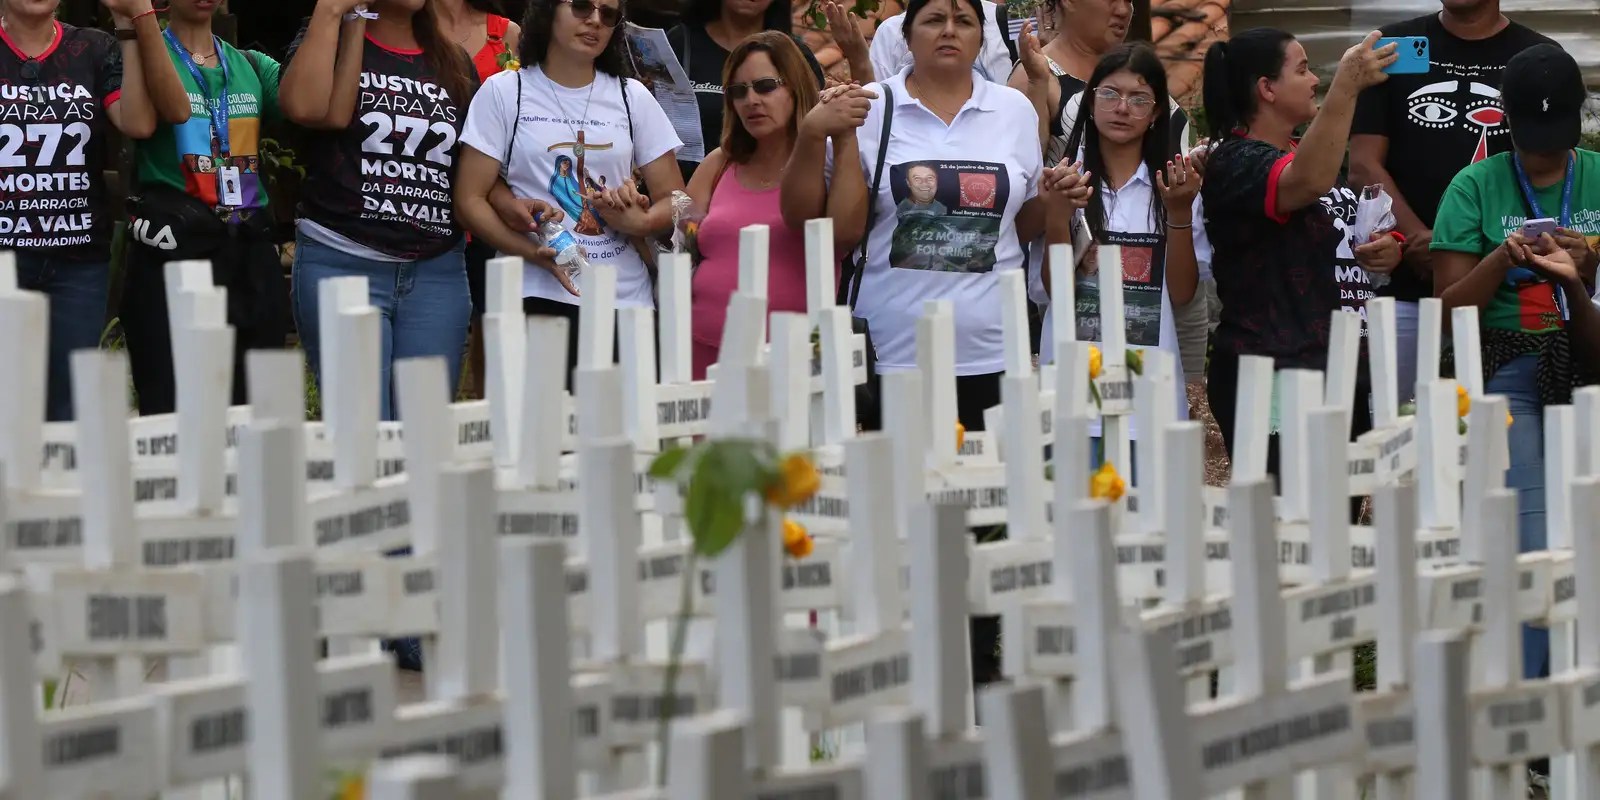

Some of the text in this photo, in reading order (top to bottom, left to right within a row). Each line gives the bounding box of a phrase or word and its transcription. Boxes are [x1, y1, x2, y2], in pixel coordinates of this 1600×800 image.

[1, 83, 92, 102] USTIÇA
[359, 72, 451, 102] JUSTIÇA
[227, 93, 257, 104] COLOGIA
[360, 92, 457, 123] PARA AS
[64, 102, 94, 120] AS
[0, 122, 92, 167] 272
[359, 111, 457, 167] 272
[0, 172, 91, 192] MORTES
[362, 158, 450, 189] MORTES
[361, 182, 380, 193] DA
[362, 195, 451, 224] DA VALE
[0, 213, 93, 234] DA VALE
[16, 234, 91, 247] BRUMADINHO
[912, 230, 933, 241] 272
[601, 251, 614, 259] das
[916, 244, 972, 258] FOI CRIME
[1340, 289, 1355, 299] DA
[1076, 302, 1097, 313] 272
[1080, 316, 1098, 328] FOI
